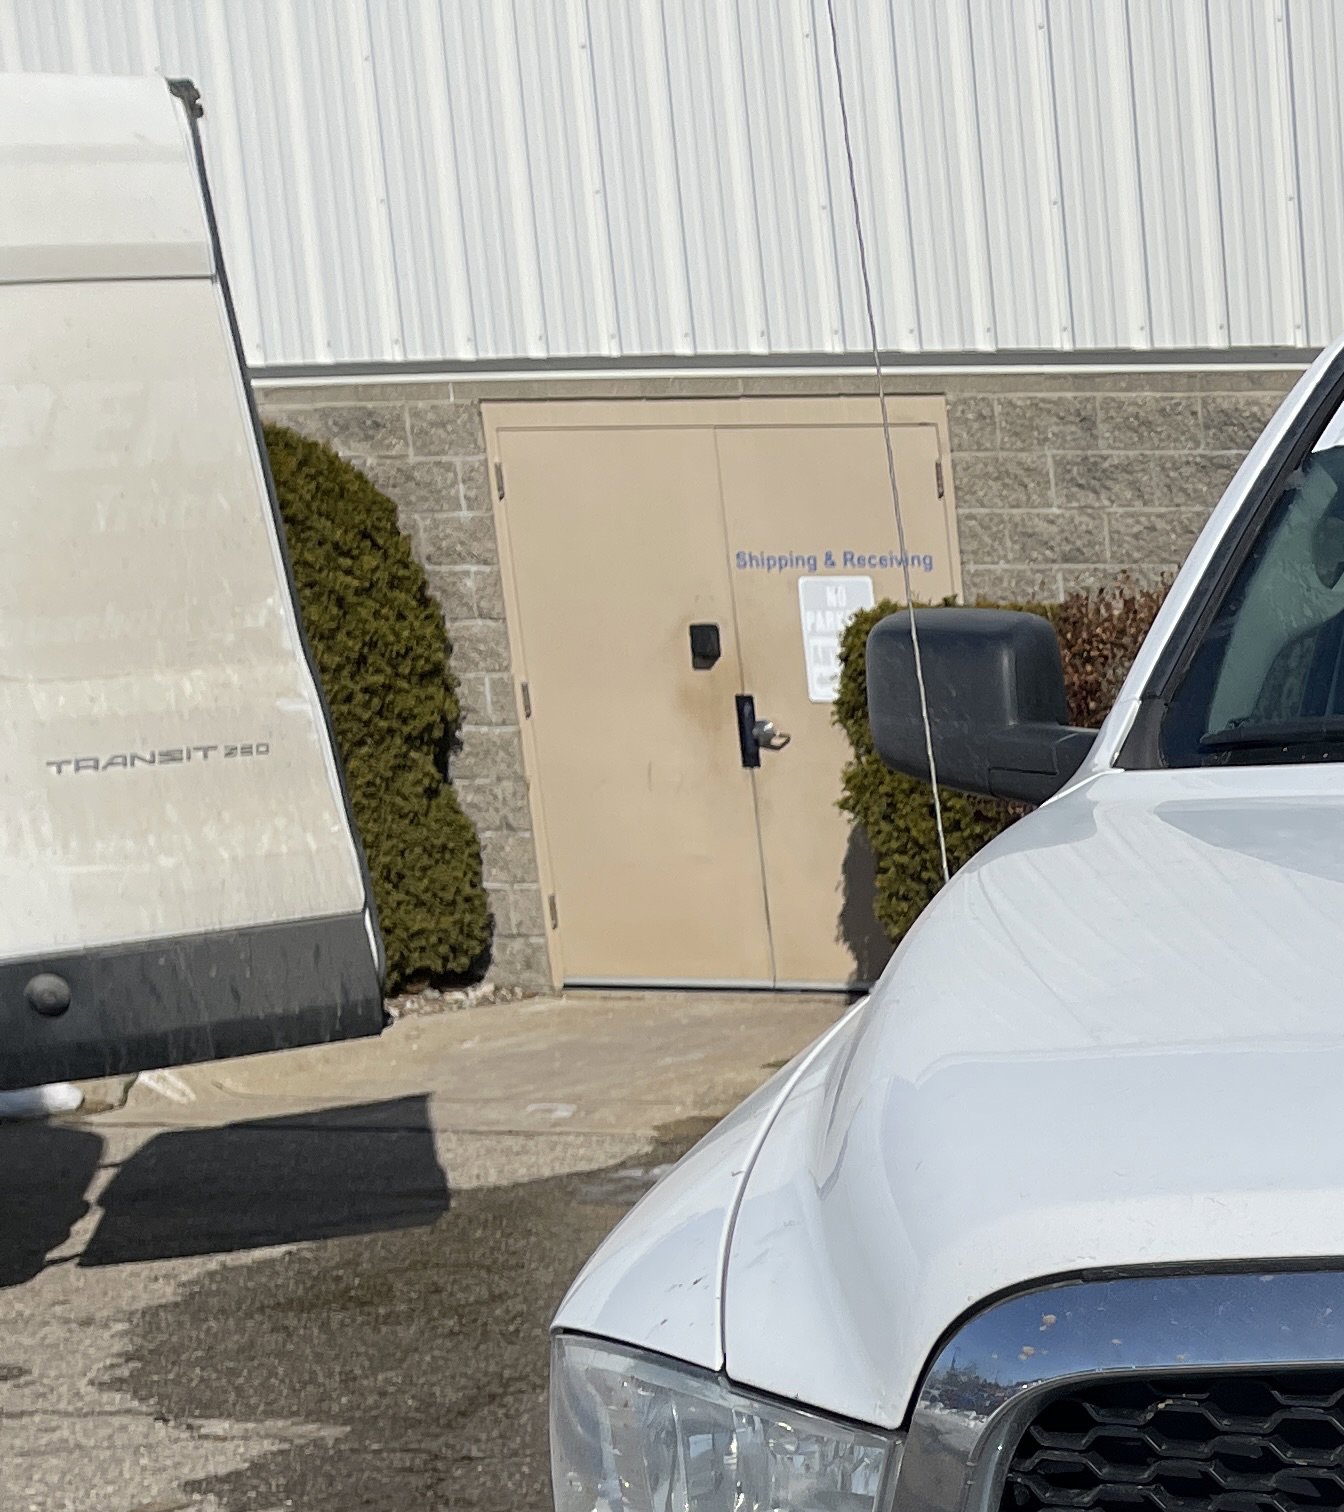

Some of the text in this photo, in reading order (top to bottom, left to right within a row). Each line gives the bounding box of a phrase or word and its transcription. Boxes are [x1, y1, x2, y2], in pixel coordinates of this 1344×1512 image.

[735, 551, 934, 572] Shipping & Receiving
[826, 585, 847, 608] NO
[46, 745, 218, 775] TRANSIT
